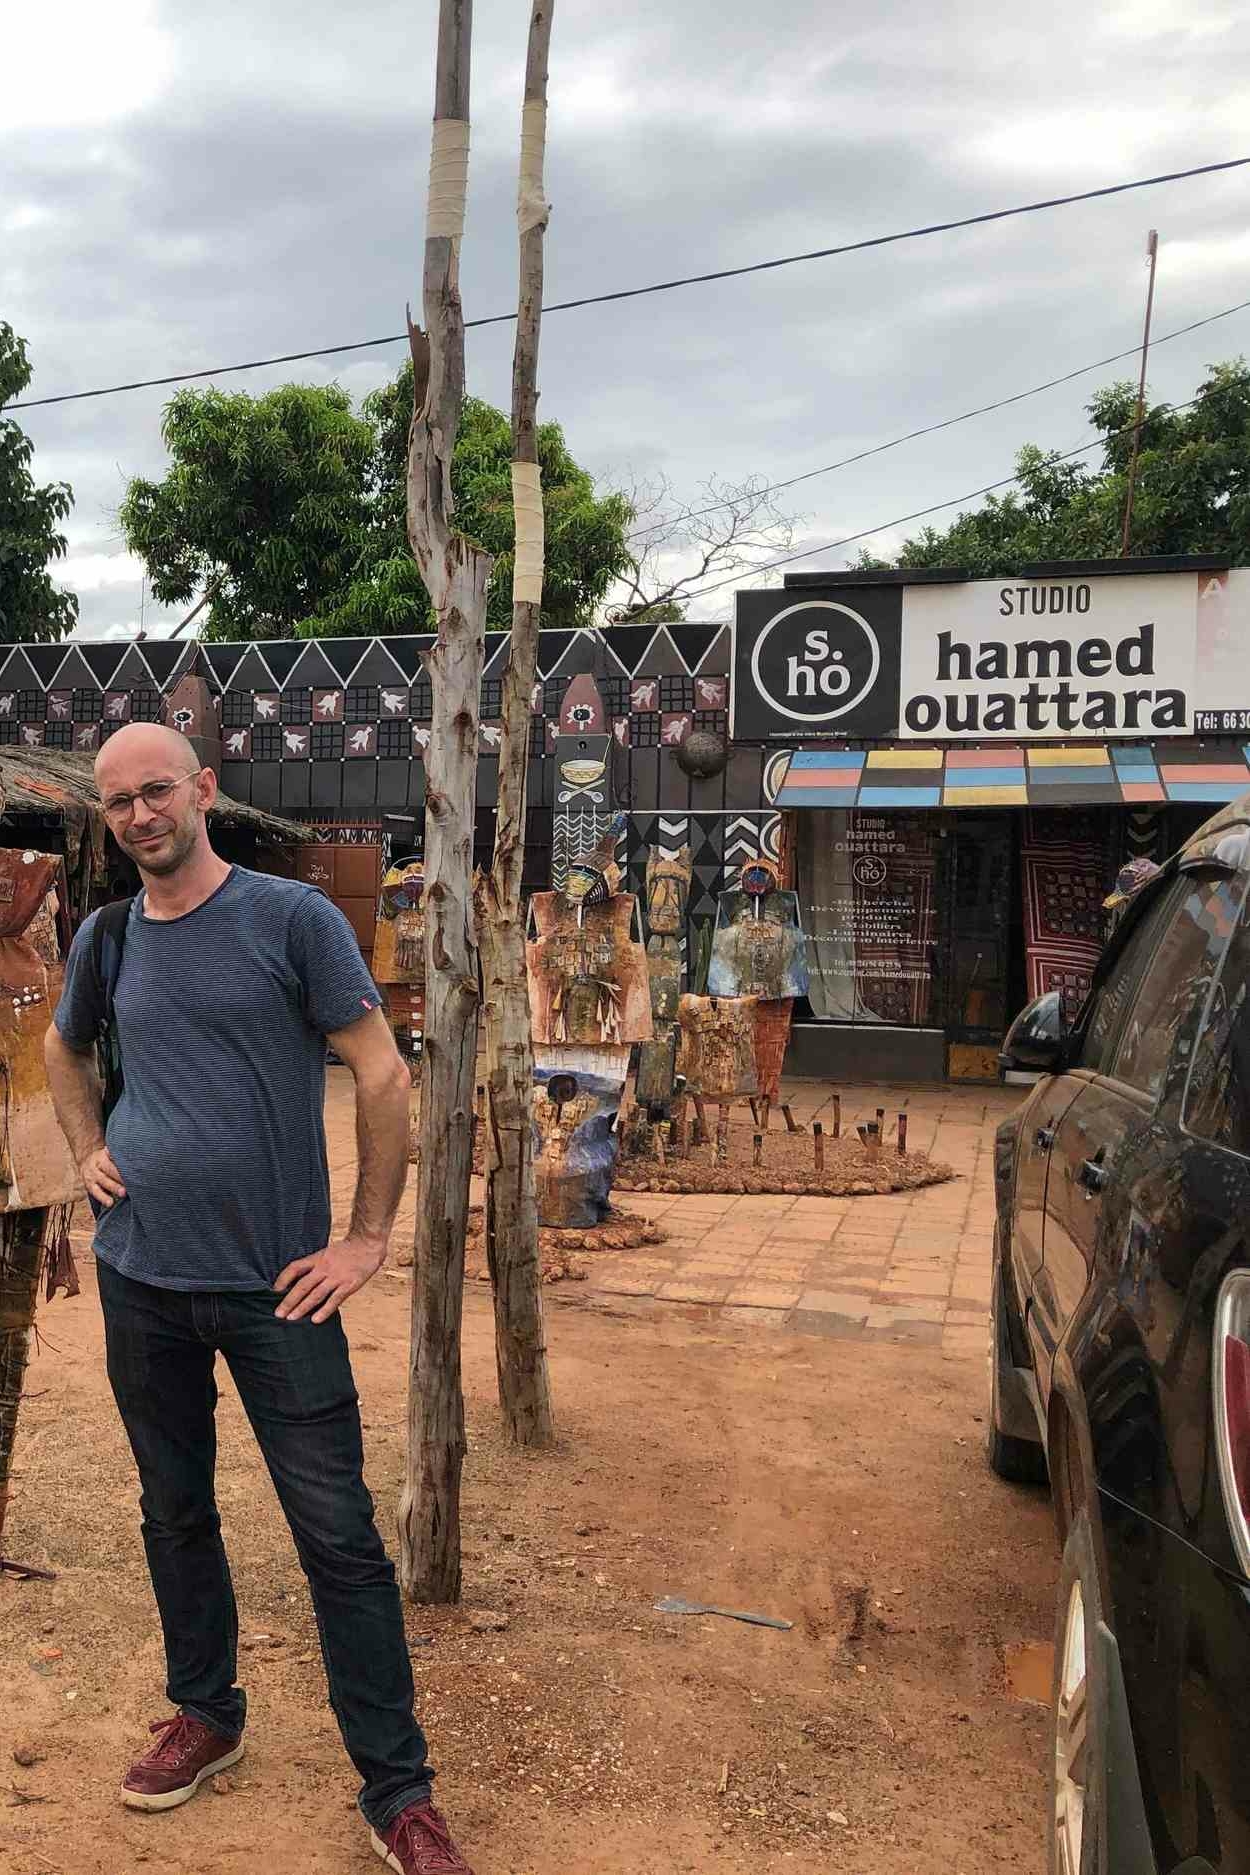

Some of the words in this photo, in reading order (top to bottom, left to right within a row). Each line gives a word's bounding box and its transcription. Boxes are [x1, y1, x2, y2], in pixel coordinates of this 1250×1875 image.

[999, 584, 1091, 616] STUDIO
[936, 623, 1155, 680] hamed
[786, 655, 851, 696] ho
[904, 682, 1187, 732] ouattara
[1196, 712, 1218, 729] Tél:
[1223, 712, 1237, 729] 66
[834, 840, 906, 853] ouattara
[845, 829, 895, 840] hamed
